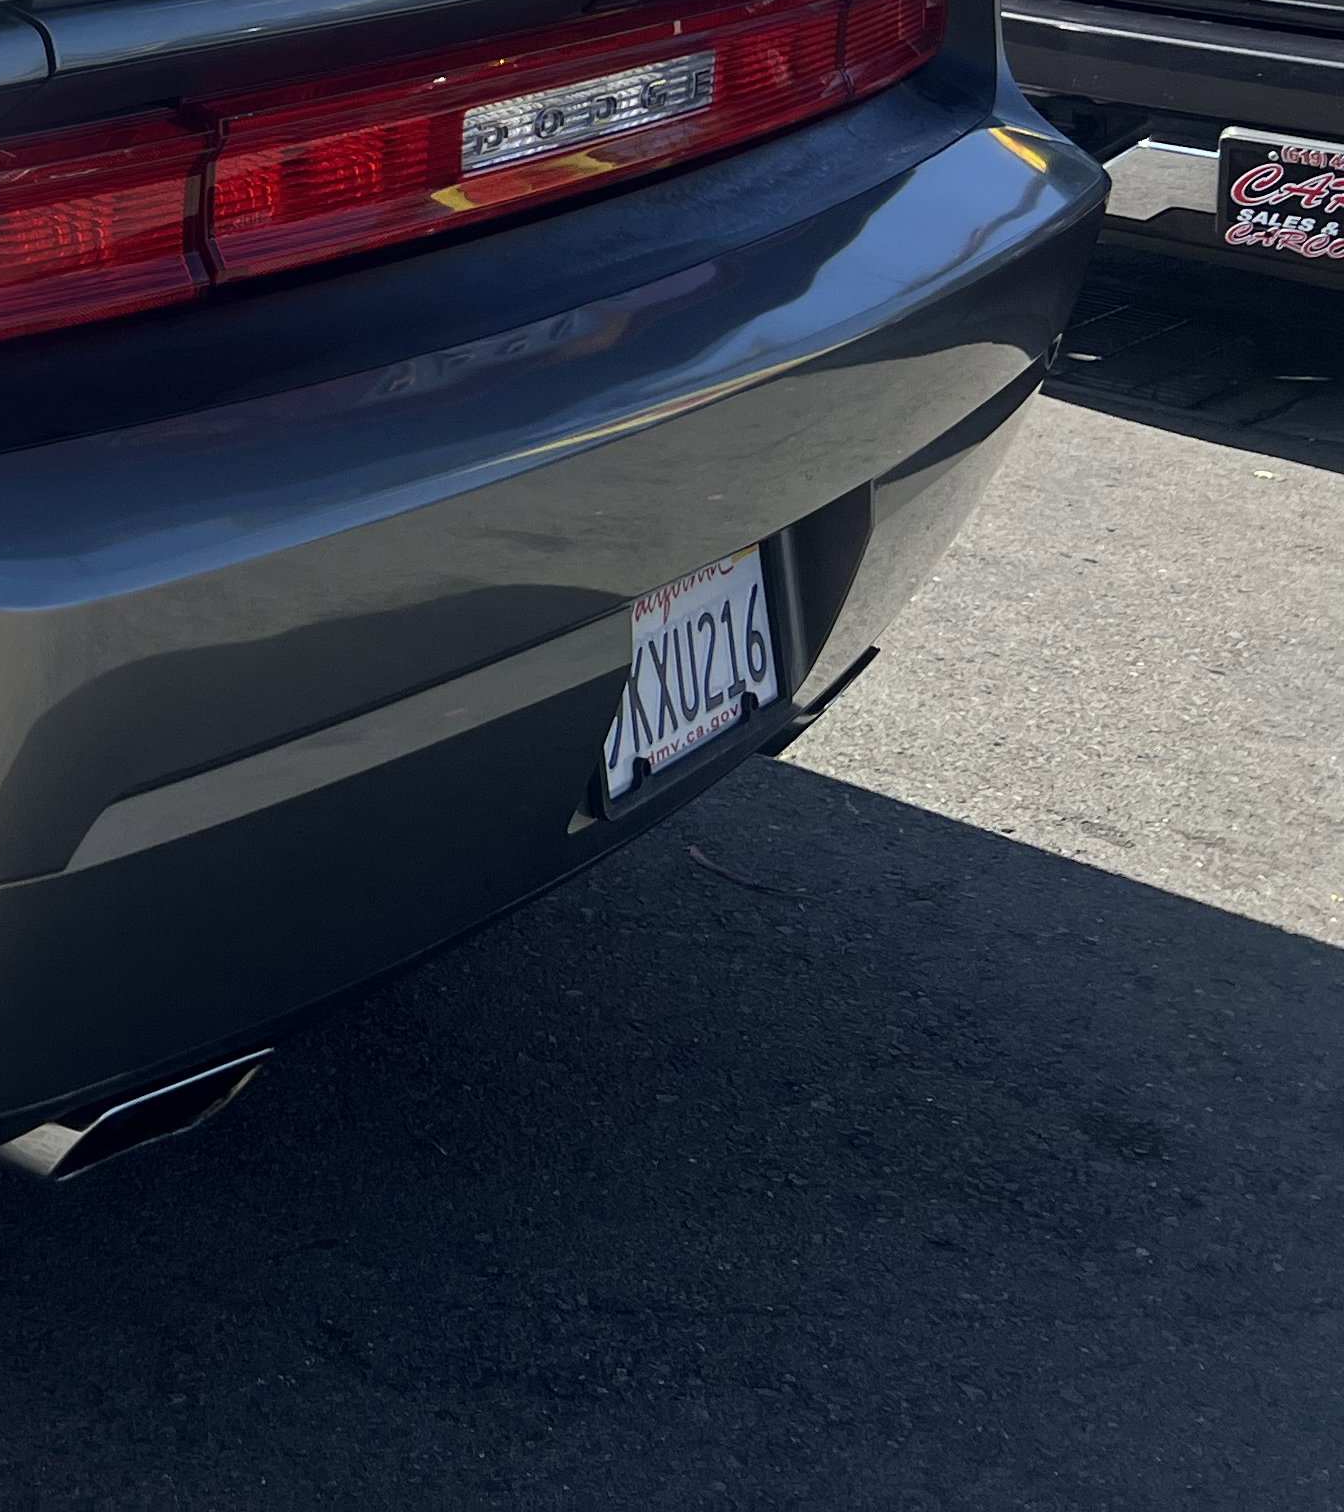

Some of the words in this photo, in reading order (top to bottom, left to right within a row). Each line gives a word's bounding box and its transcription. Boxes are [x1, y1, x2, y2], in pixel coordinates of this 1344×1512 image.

[475, 70, 712, 156] DODGE
[1281, 144, 1328, 169] (619)
[1236, 208, 1316, 232] SALES
[1320, 221, 1340, 236] &
